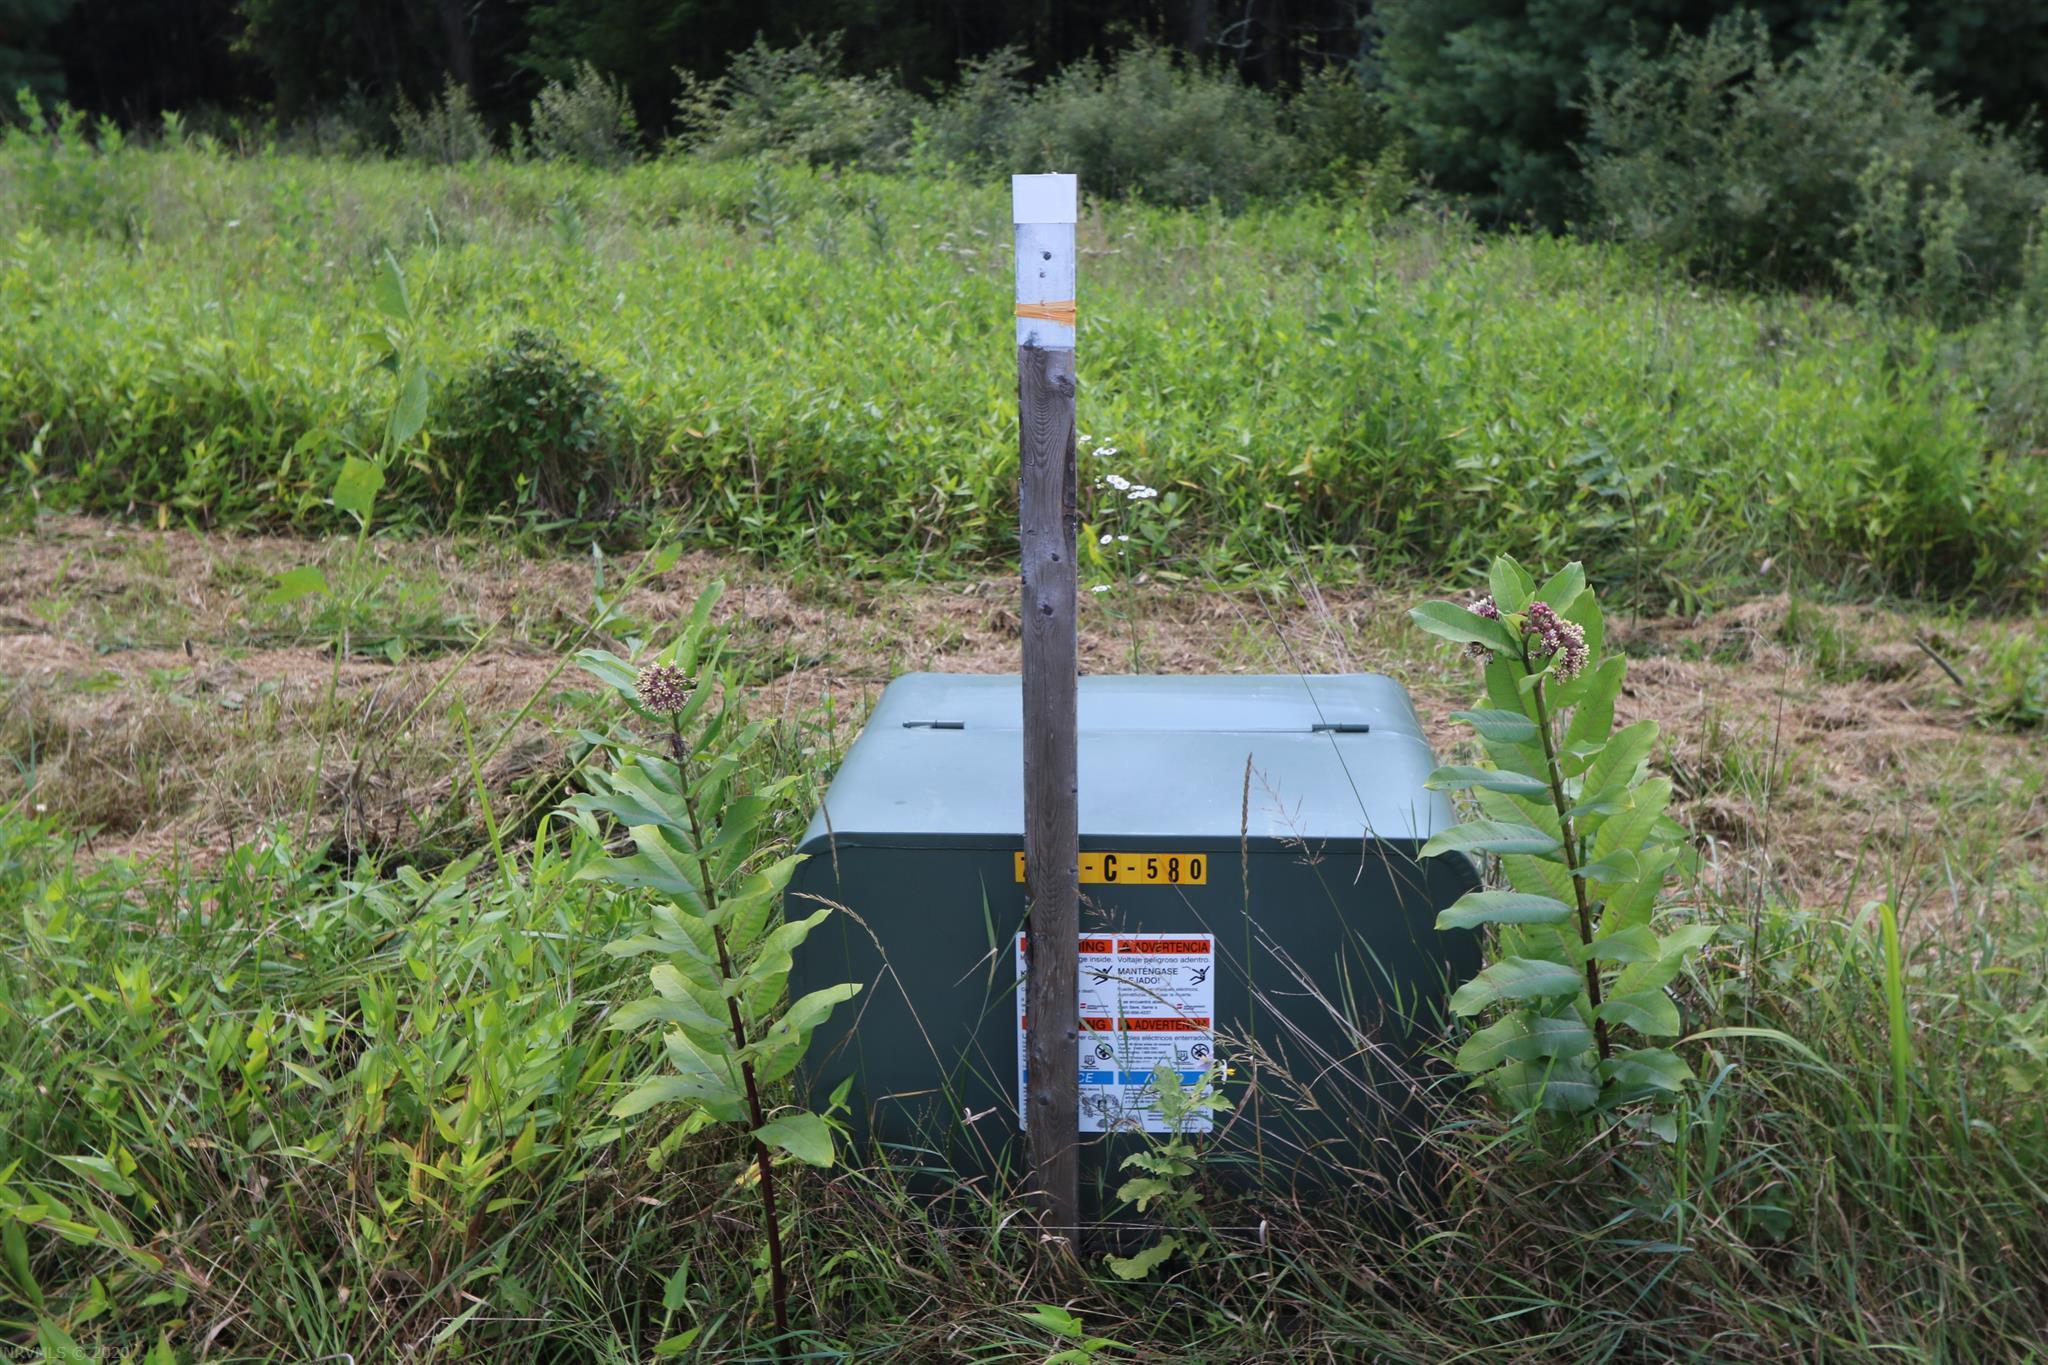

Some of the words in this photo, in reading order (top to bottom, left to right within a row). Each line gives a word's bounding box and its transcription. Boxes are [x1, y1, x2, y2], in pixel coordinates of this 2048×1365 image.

[1135, 941, 1208, 953] ADVERTENCIA
[1117, 956, 1142, 964] Voltaje
[1144, 956, 1178, 964] peligroso
